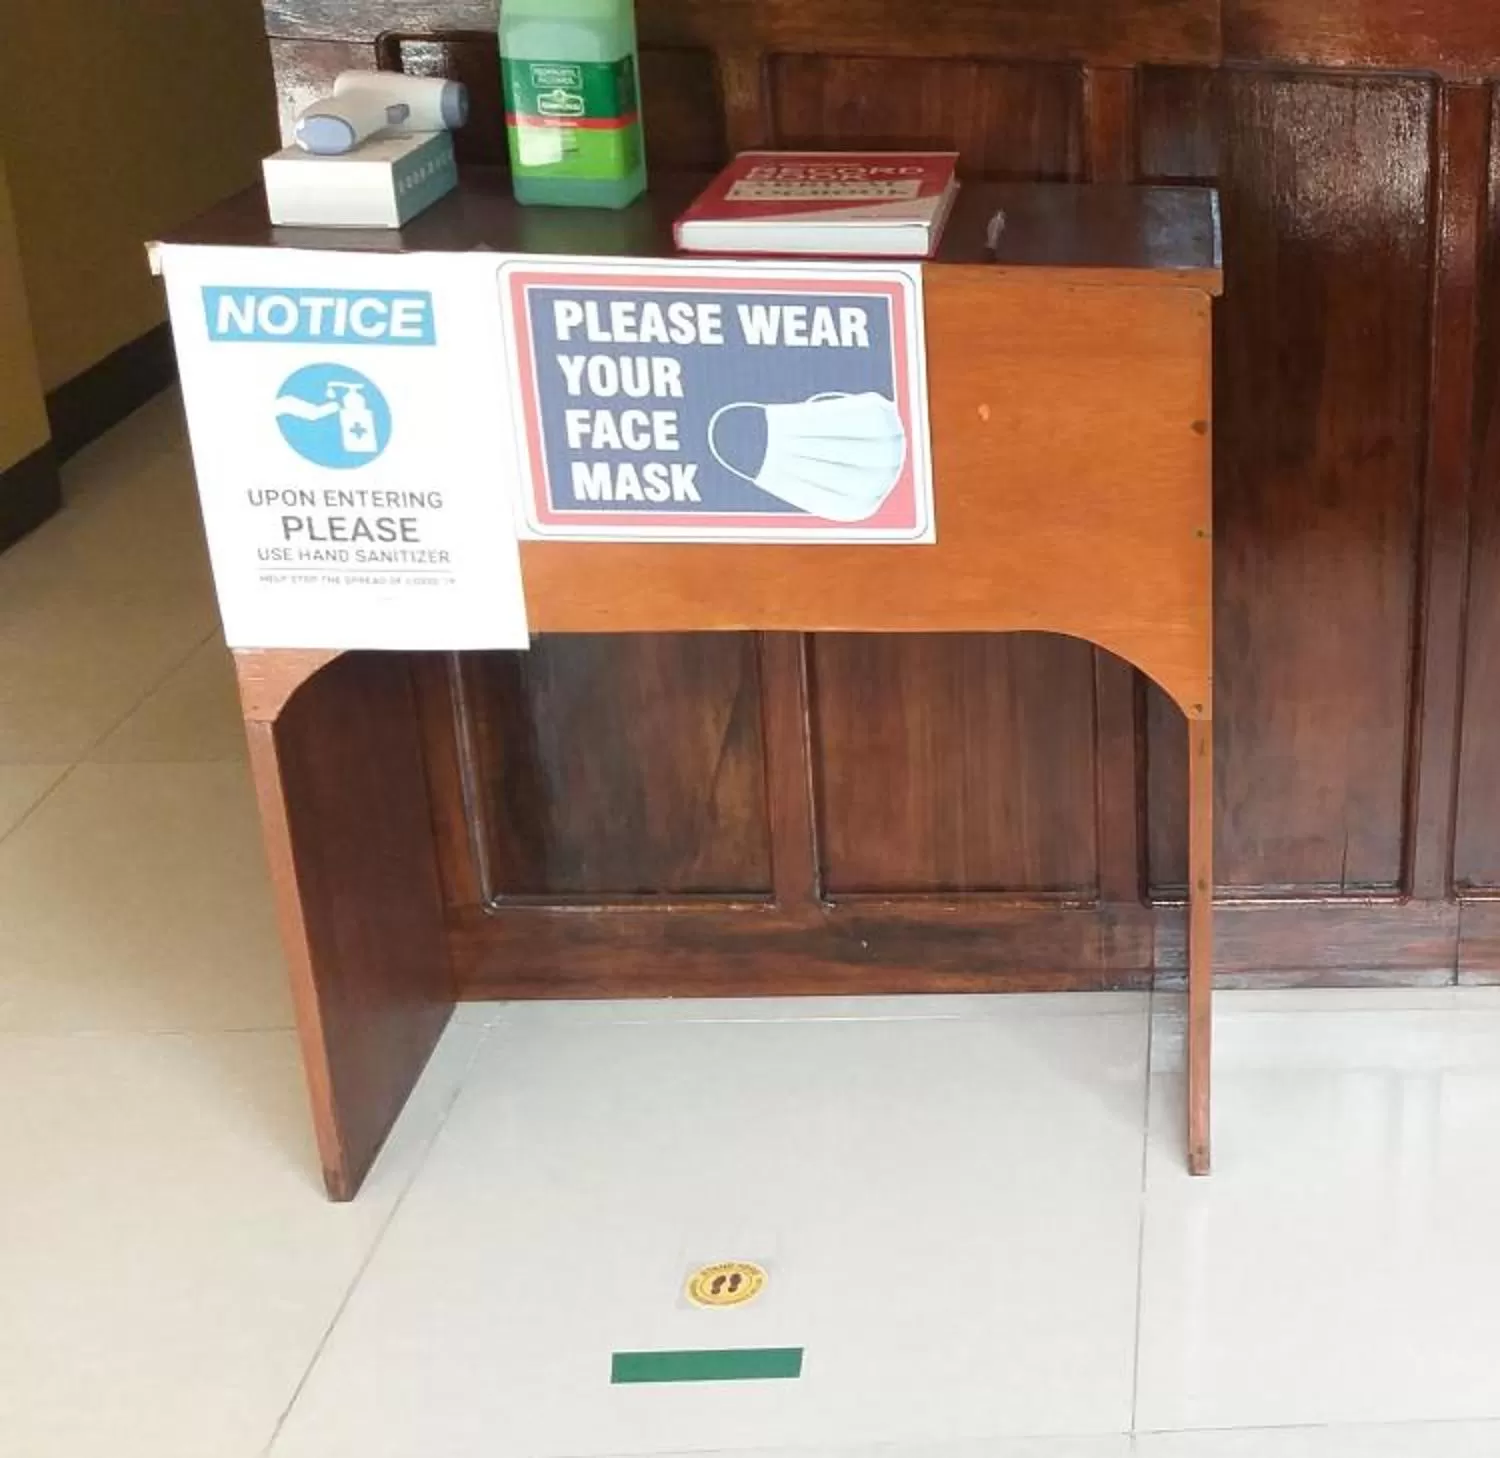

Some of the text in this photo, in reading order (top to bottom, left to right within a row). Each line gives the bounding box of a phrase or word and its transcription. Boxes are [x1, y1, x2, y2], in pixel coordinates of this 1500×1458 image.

[216, 294, 426, 338] NOTICE
[553, 300, 869, 348] PLEASE WEAR
[556, 354, 684, 398] YOUR
[565, 409, 680, 452] FACE
[247, 488, 443, 509] UPON ENTERING
[571, 462, 701, 502] MASK
[281, 515, 421, 543] PLEASE
[257, 547, 451, 564] USE HAND SANITIZER
[321, 575, 341, 585] THE
